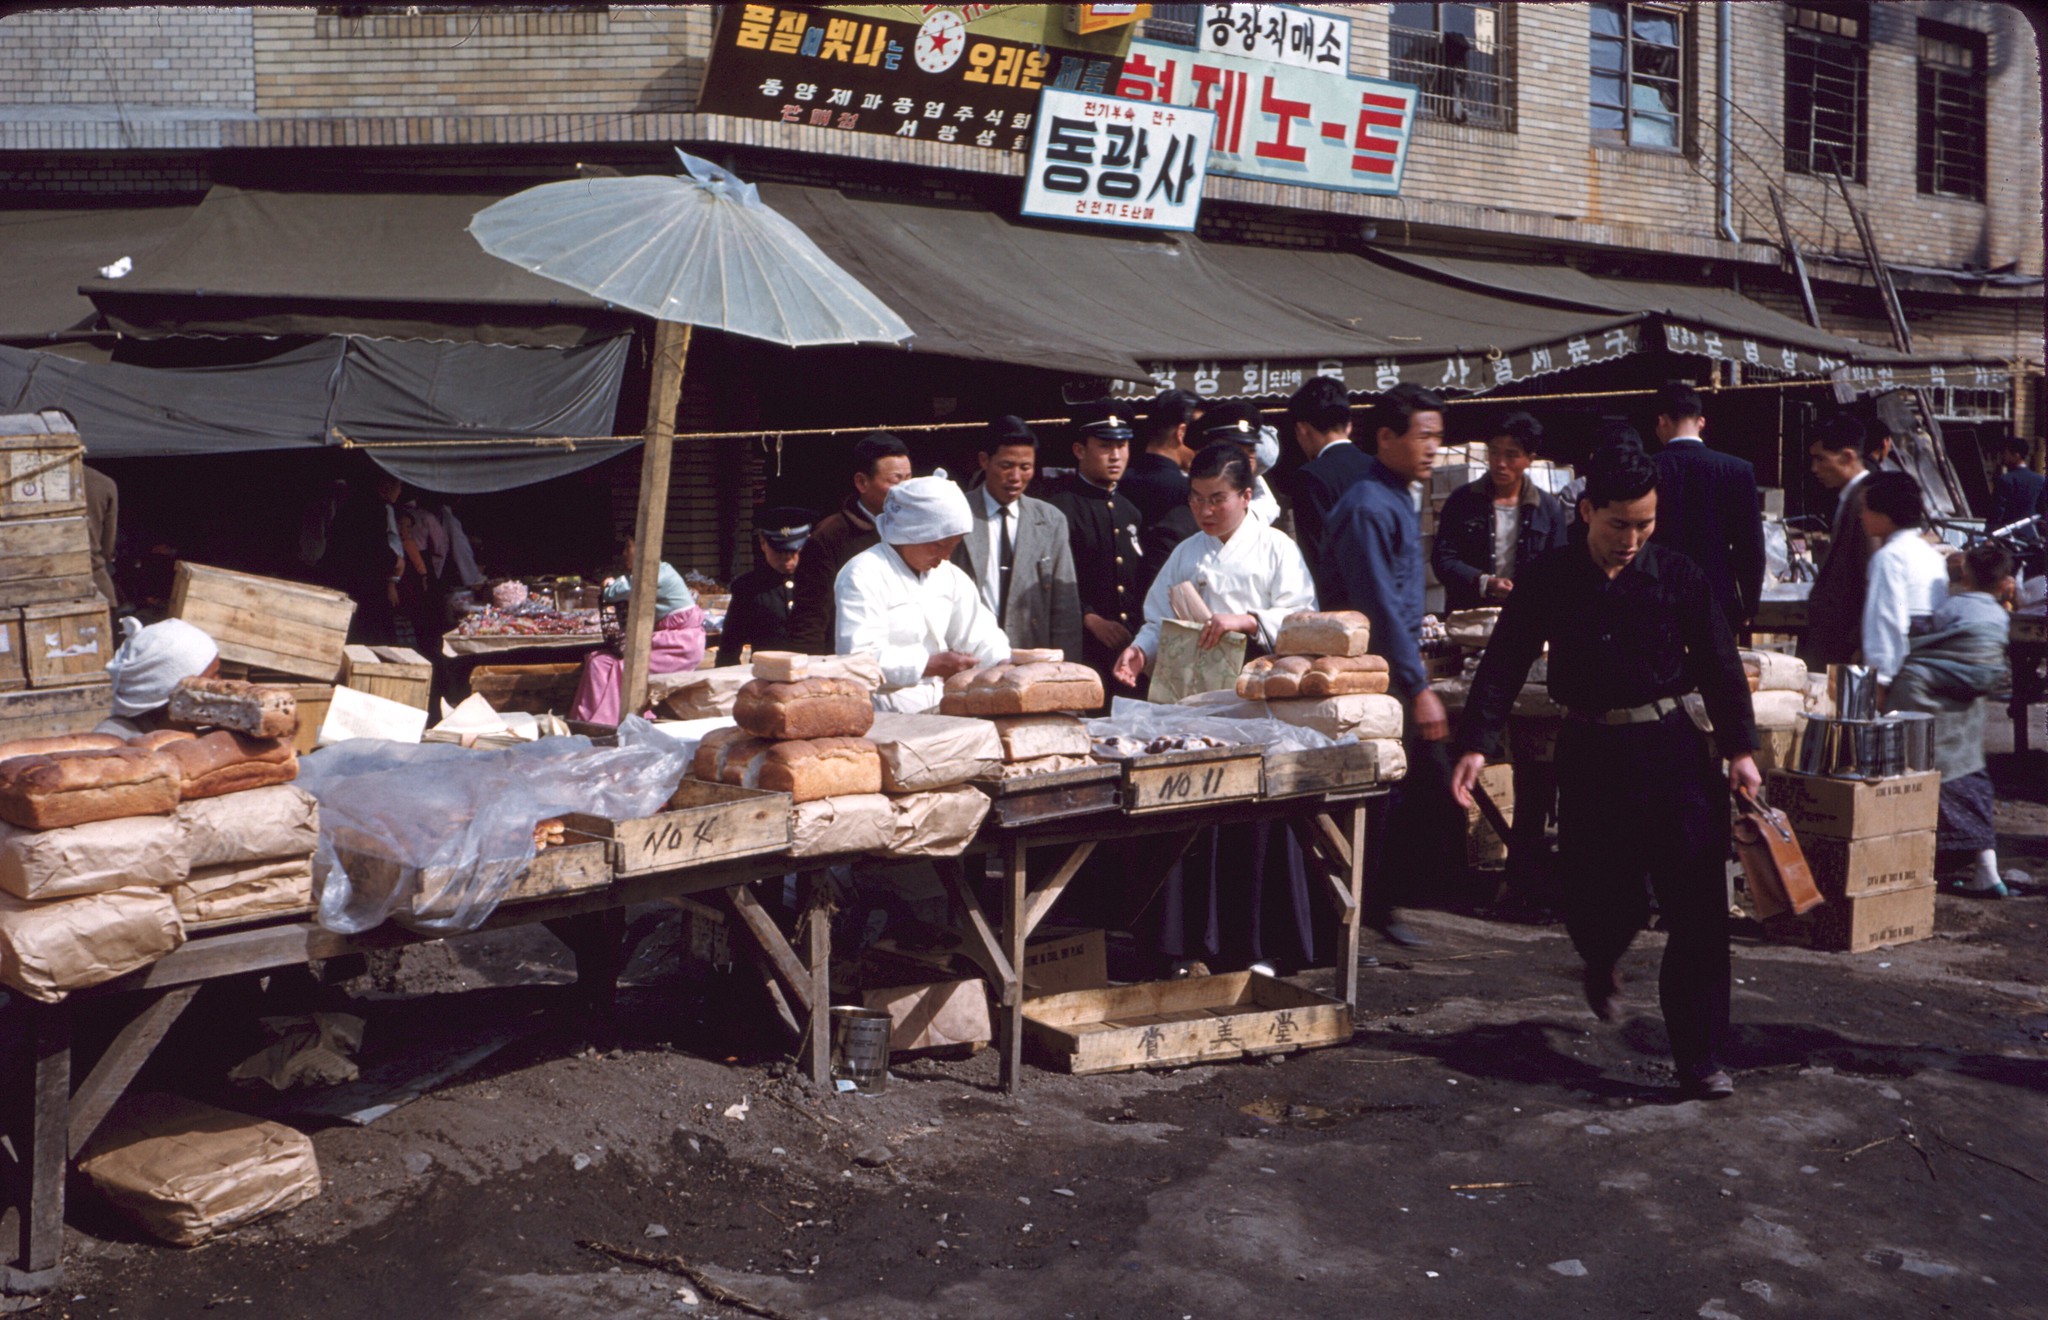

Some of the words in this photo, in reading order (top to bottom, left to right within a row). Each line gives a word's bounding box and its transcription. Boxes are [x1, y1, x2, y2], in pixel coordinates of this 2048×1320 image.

[1207, 4, 1341, 66] 공장직매소
[963, 43, 1051, 90] 오리온
[1042, 115, 1195, 206] 동광사
[1159, 772, 1191, 799] NO
[1203, 767, 1224, 795] 11
[643, 822, 682, 856] NO
